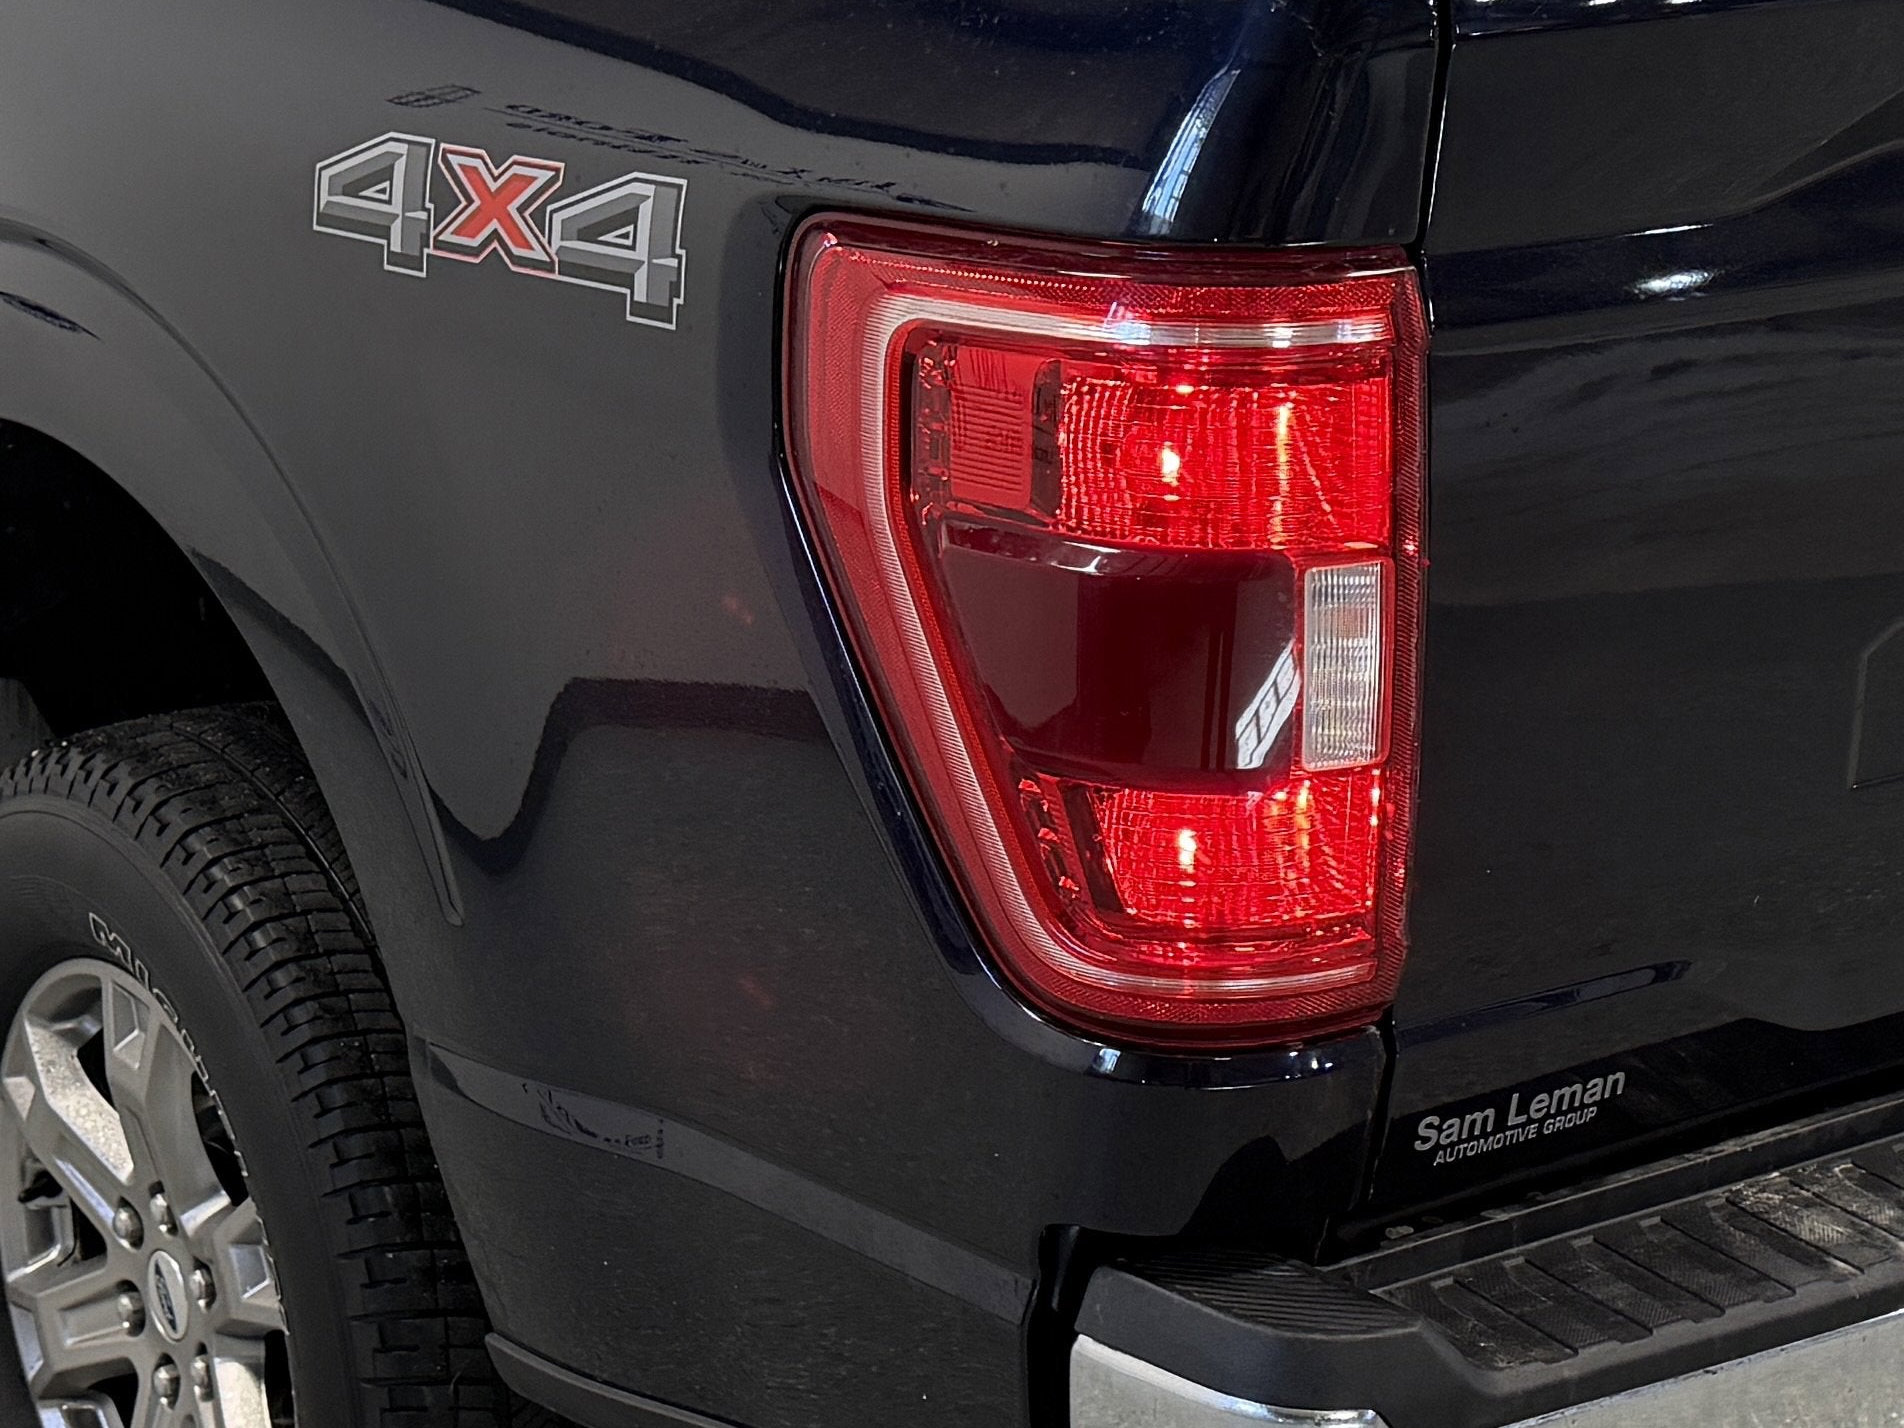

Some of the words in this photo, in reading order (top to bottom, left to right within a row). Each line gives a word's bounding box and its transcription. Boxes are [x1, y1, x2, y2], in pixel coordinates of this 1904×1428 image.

[1414, 1108, 1496, 1152] Sam
[1507, 1071, 1626, 1126] Leman
[1433, 1123, 1538, 1166] AUTOMOTIVE
[1543, 1106, 1598, 1135] GROUP
